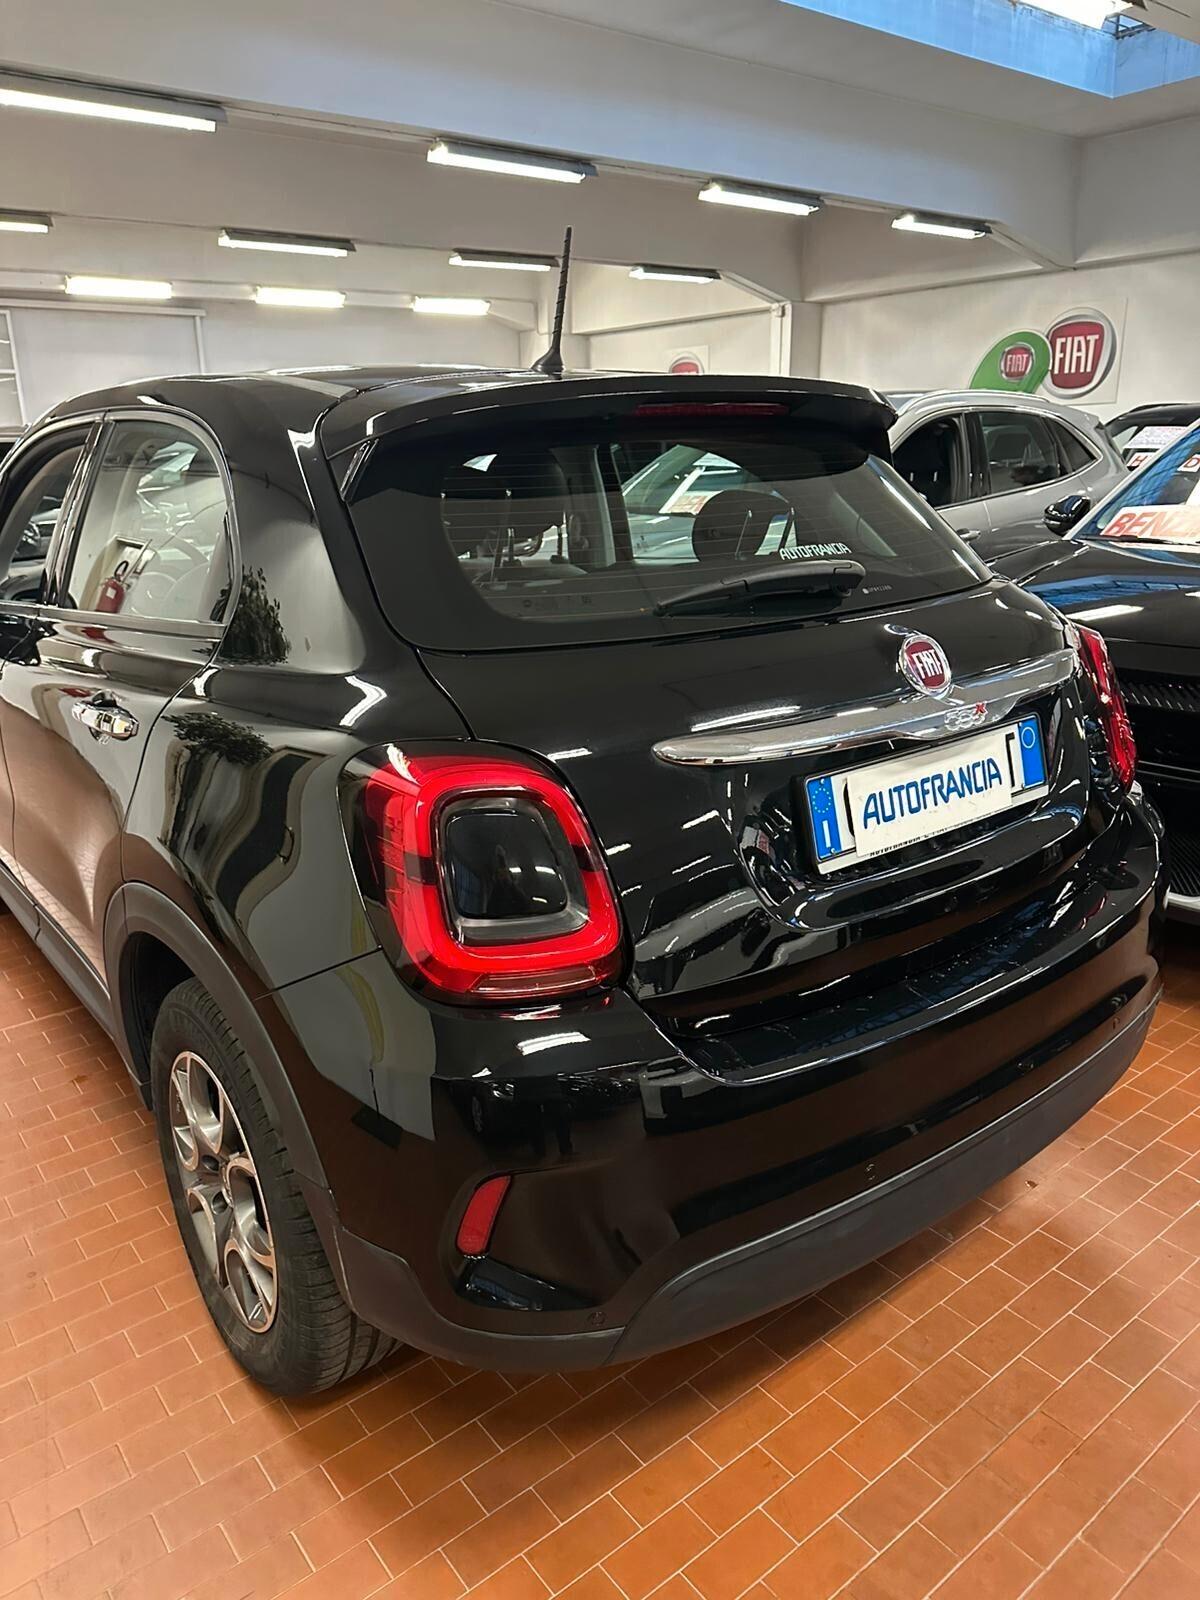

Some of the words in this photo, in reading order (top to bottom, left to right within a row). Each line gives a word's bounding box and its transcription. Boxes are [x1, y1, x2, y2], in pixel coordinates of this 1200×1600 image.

[1006, 353, 1029, 373] FIAT
[1054, 334, 1099, 375] FIAT
[779, 542, 852, 561] AUTOFRANCIA
[911, 649, 943, 679] FIAT
[862, 757, 1003, 830] AUTOFRANCIA
